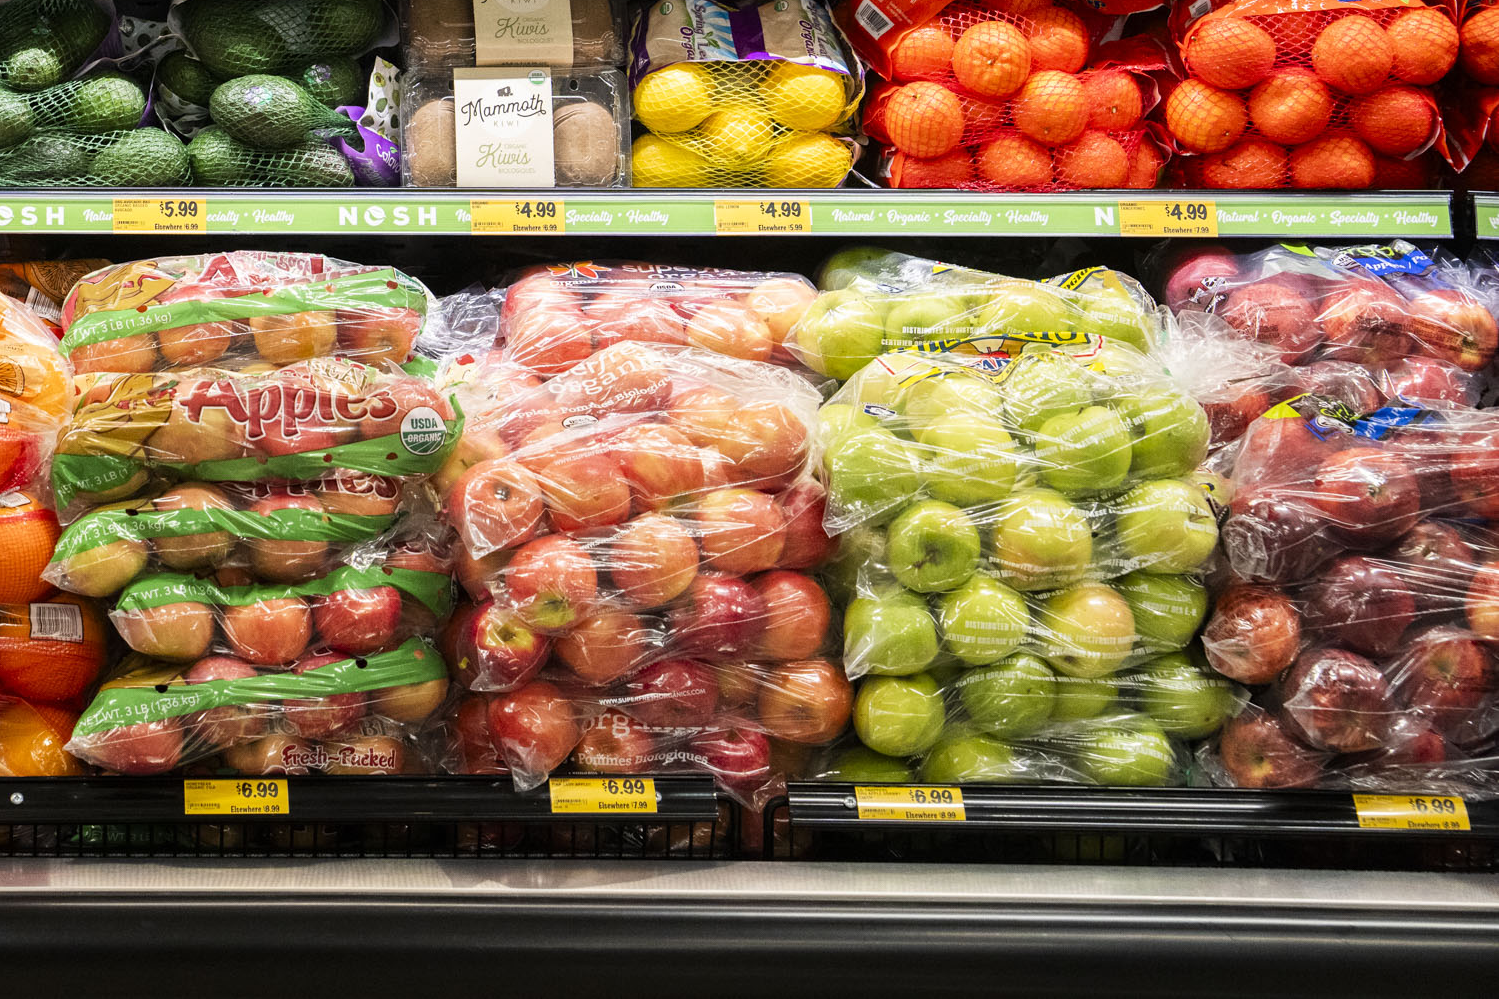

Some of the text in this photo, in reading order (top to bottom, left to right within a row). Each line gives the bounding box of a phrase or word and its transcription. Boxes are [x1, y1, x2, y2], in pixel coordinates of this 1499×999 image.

[461, 95, 546, 126] Mammoth
[477, 143, 532, 168] Kiwis
[159, 201, 198, 218] $5.99
[515, 201, 556, 218] $4.99
[566, 210, 669, 226] Specialty Healthy
[759, 201, 802, 218] $4.99
[832, 209, 1049, 224] Natural Organic Specialty Healthy
[1165, 204, 1207, 220] $4.99
[1216, 210, 1438, 226] Natural Organic Specialty Healthy
[180, 381, 400, 441] Apples
[410, 418, 438, 430] USDA
[126, 707, 132, 716] 3
[236, 782, 279, 798] $6.99
[602, 778, 646, 795] $6.99
[909, 788, 953, 805] $6.99
[230, 805, 262, 813] Elsewhere
[1409, 797, 1456, 815] $6.99
